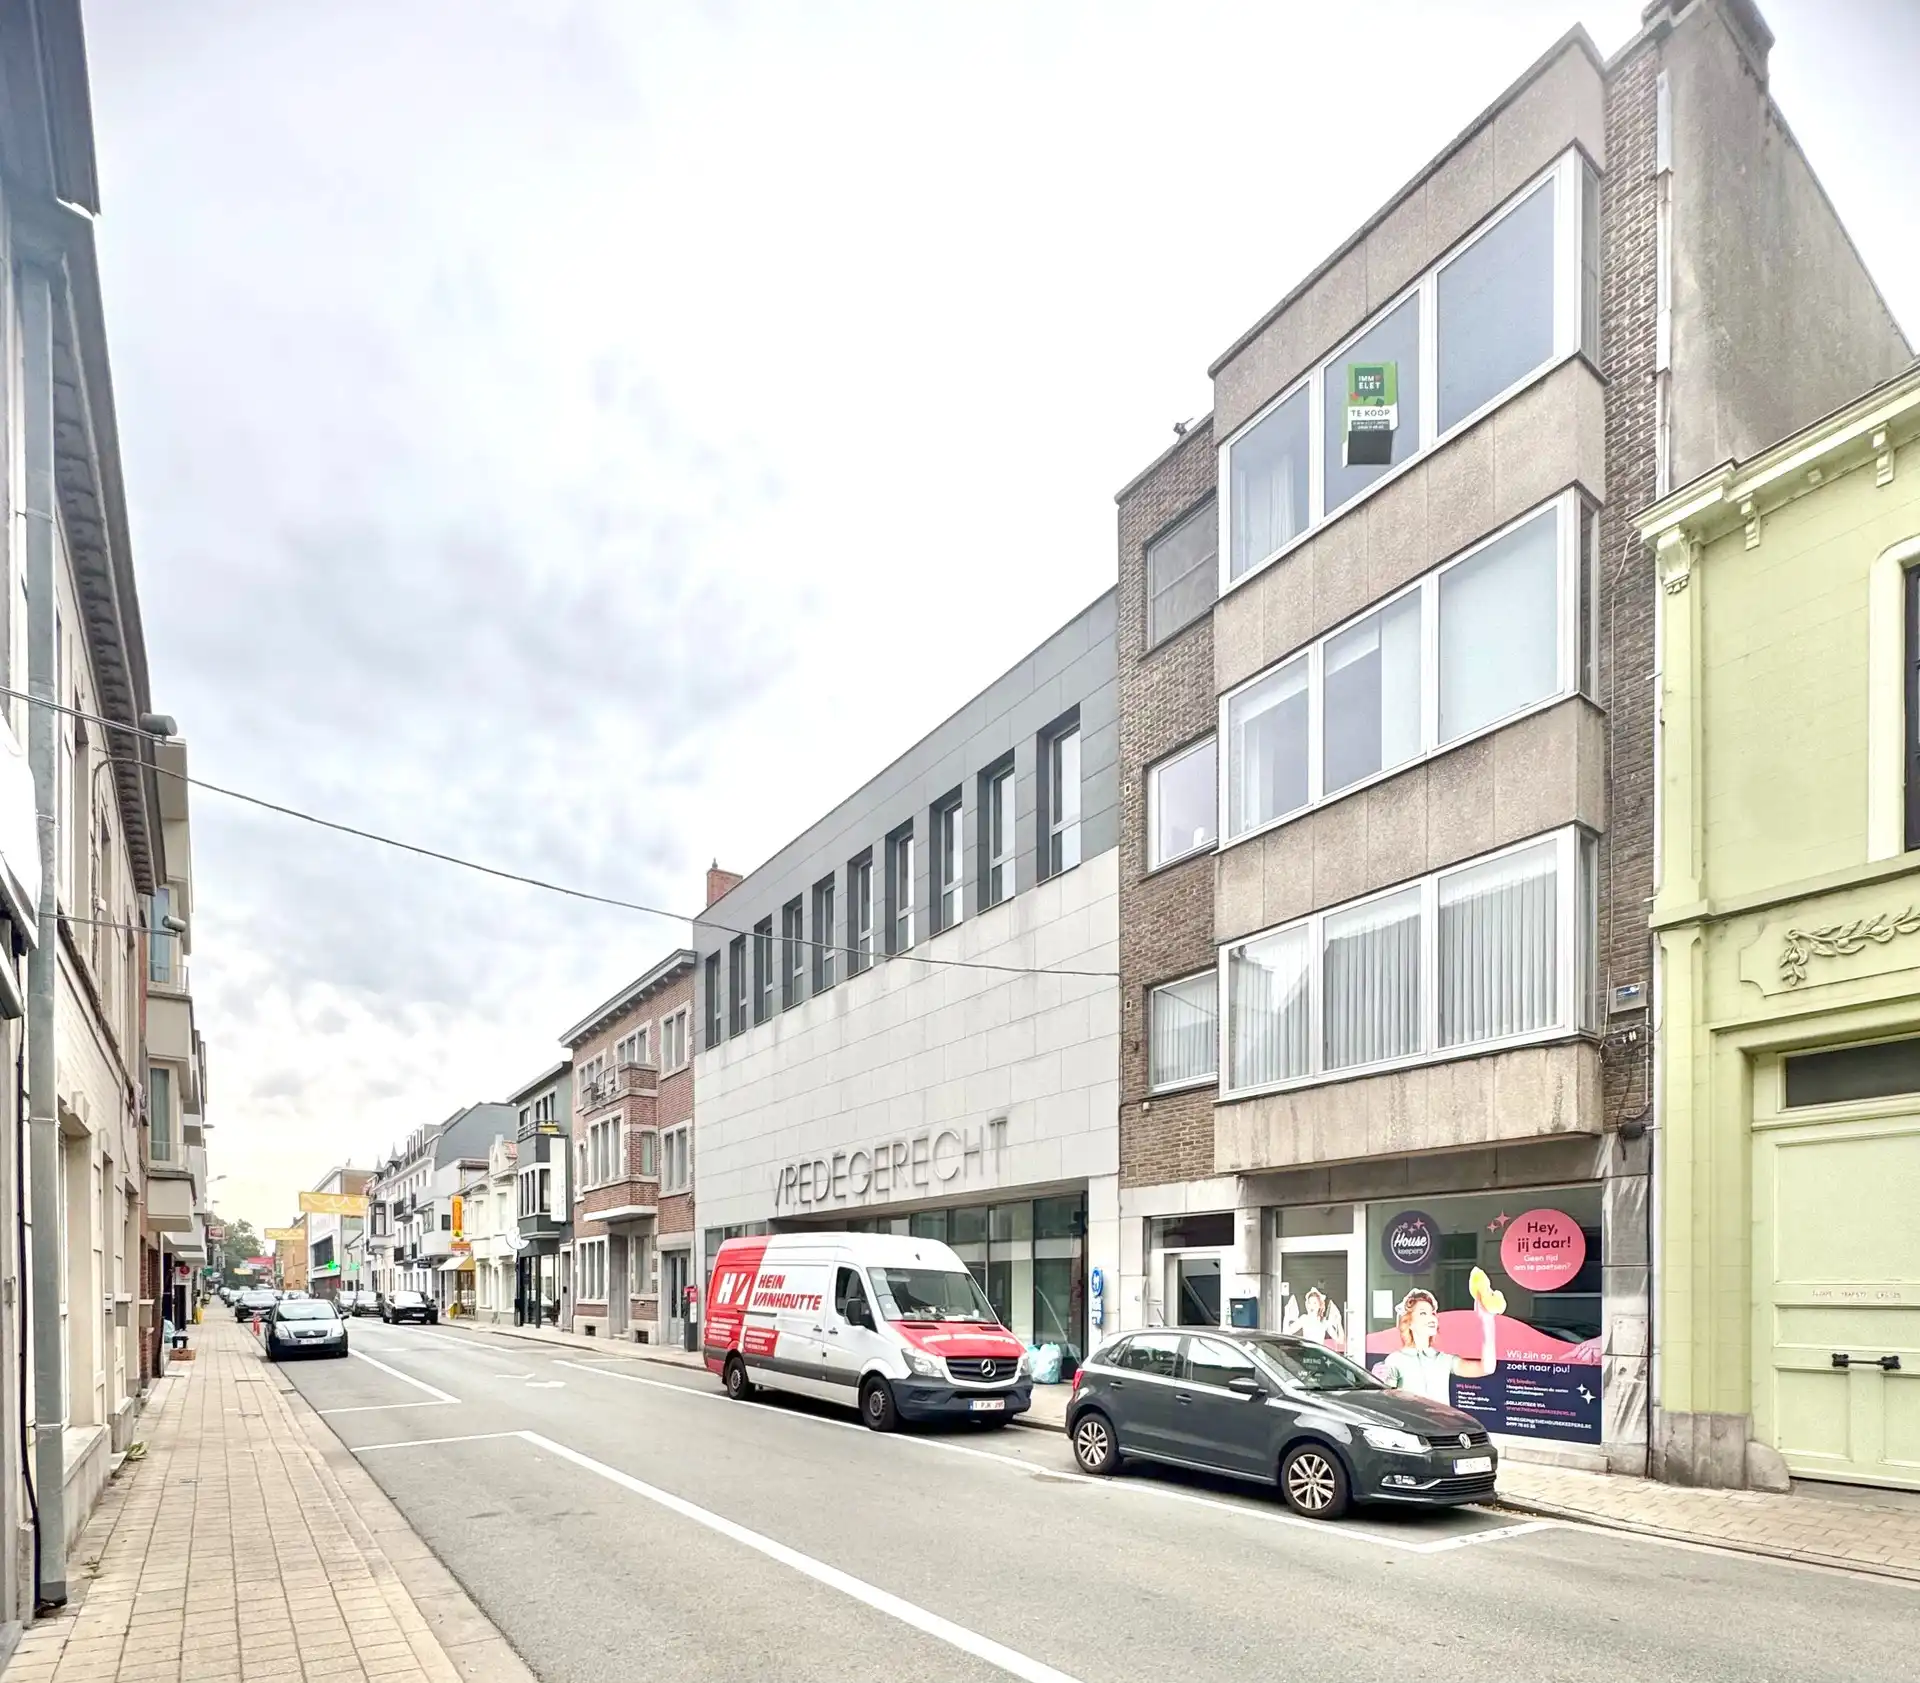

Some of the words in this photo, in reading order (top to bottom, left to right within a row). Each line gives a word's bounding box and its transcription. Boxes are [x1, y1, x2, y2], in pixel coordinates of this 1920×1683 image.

[1351, 409, 1362, 417] TE
[1364, 409, 1391, 417] KOOP
[773, 1116, 1007, 1206] VREDEGERECHT
[1527, 1221, 1558, 1236] Hey,
[1393, 1232, 1427, 1247] House
[1517, 1237, 1529, 1252] jij
[1532, 1236, 1571, 1249] daar!
[1523, 1254, 1544, 1262] Geen
[758, 1274, 786, 1289] HEIN
[752, 1292, 823, 1311] VANHOUTTE
[1506, 1350, 1521, 1360] Wij
[1523, 1351, 1538, 1360] zijn
[1540, 1353, 1553, 1361] op
[1506, 1362, 1528, 1370] zoek
[1529, 1364, 1551, 1372] naar
[1552, 1364, 1570, 1374] jou!
